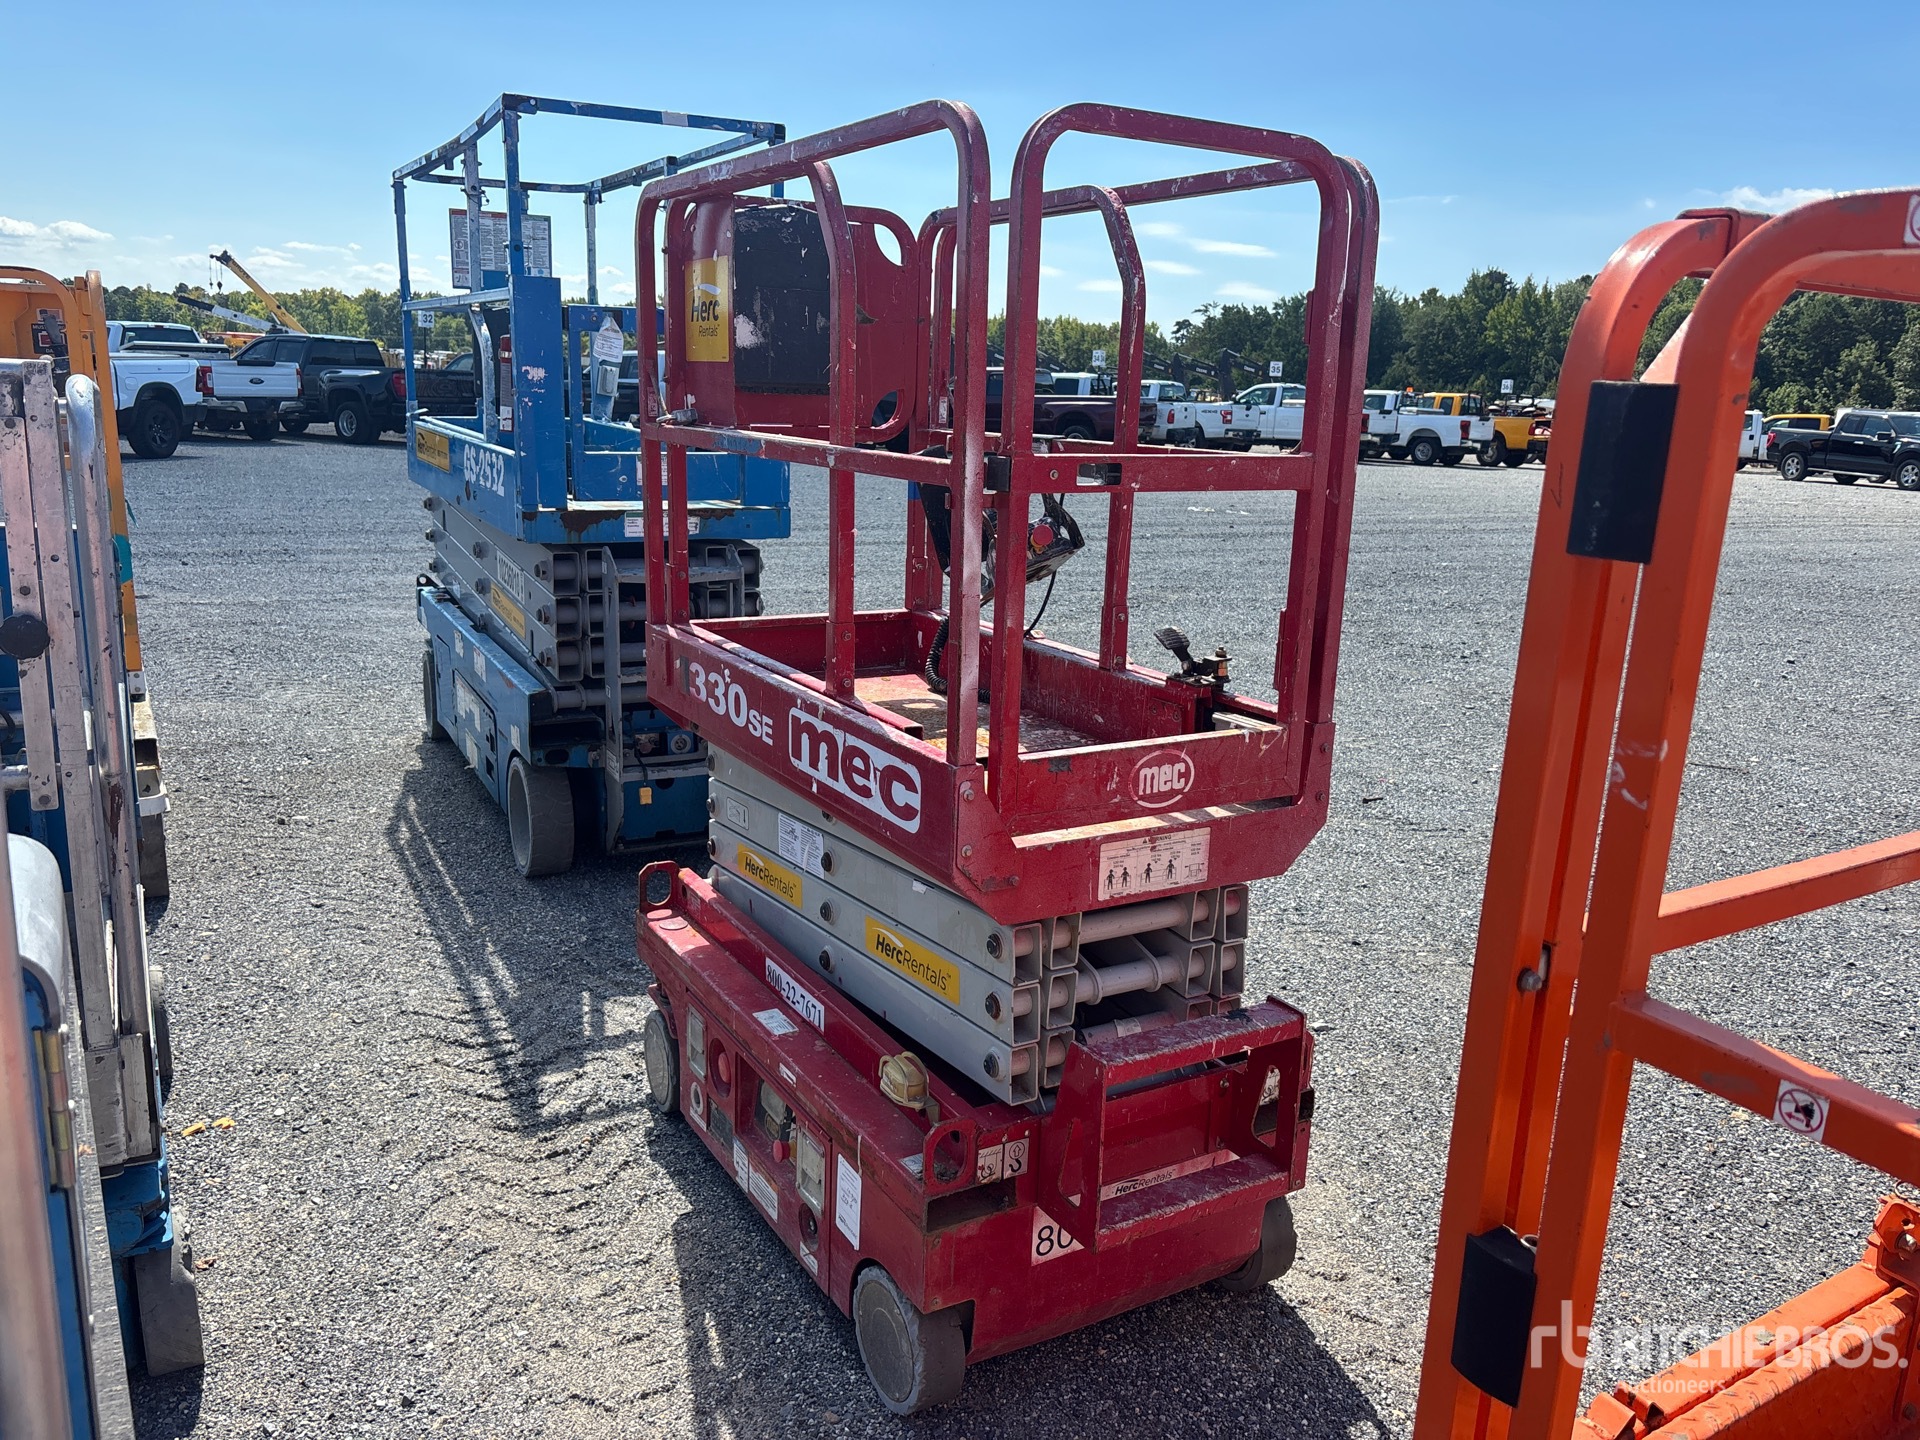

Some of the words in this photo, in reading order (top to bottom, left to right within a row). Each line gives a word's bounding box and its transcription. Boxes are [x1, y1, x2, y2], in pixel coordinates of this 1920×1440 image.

[422, 313, 433, 323] 32
[691, 295, 721, 322] Herc
[699, 325, 719, 337] Rentals
[1270, 366, 1281, 374] 35
[791, 712, 919, 822] mec
[1138, 762, 1186, 796] mec
[766, 964, 823, 1029] 800-22-7671
[1035, 1225, 1074, 1257] 80
